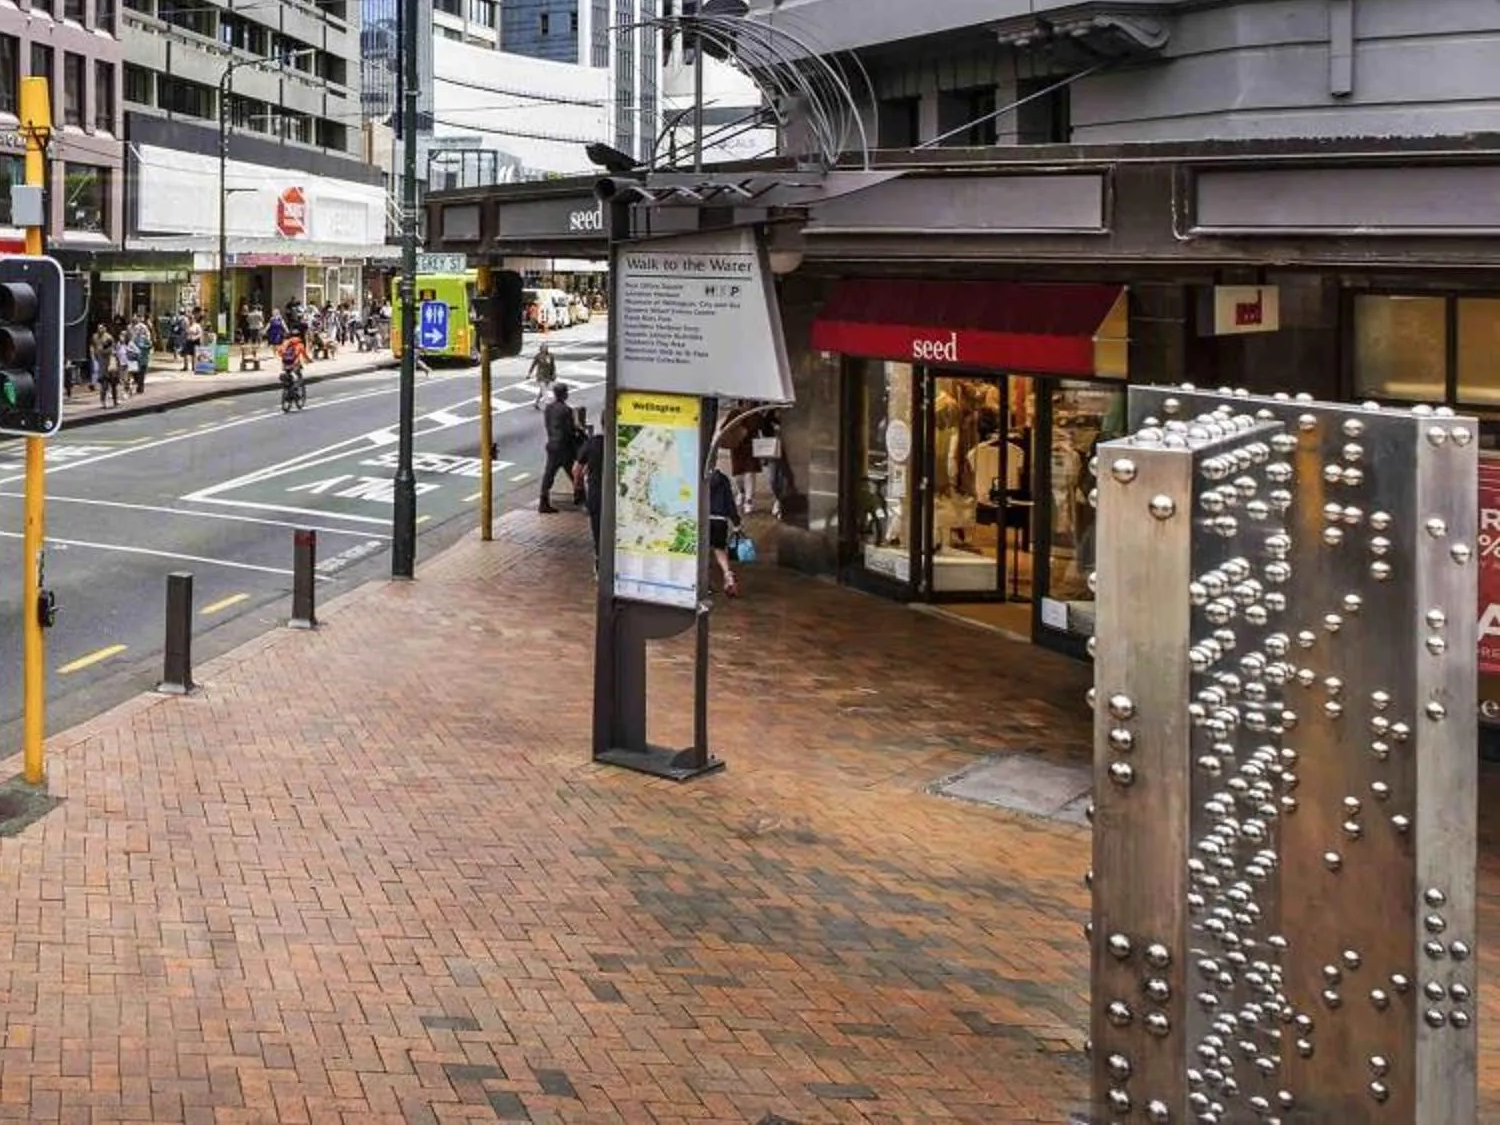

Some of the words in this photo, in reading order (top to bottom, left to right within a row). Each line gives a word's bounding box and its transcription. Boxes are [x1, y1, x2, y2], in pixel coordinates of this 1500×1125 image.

[569, 199, 603, 230] seed
[627, 257, 658, 270] Walk
[663, 258, 678, 270] to
[683, 258, 705, 271] the
[710, 258, 752, 272] Water
[913, 332, 958, 361] seed
[631, 402, 682, 413] Wellington
